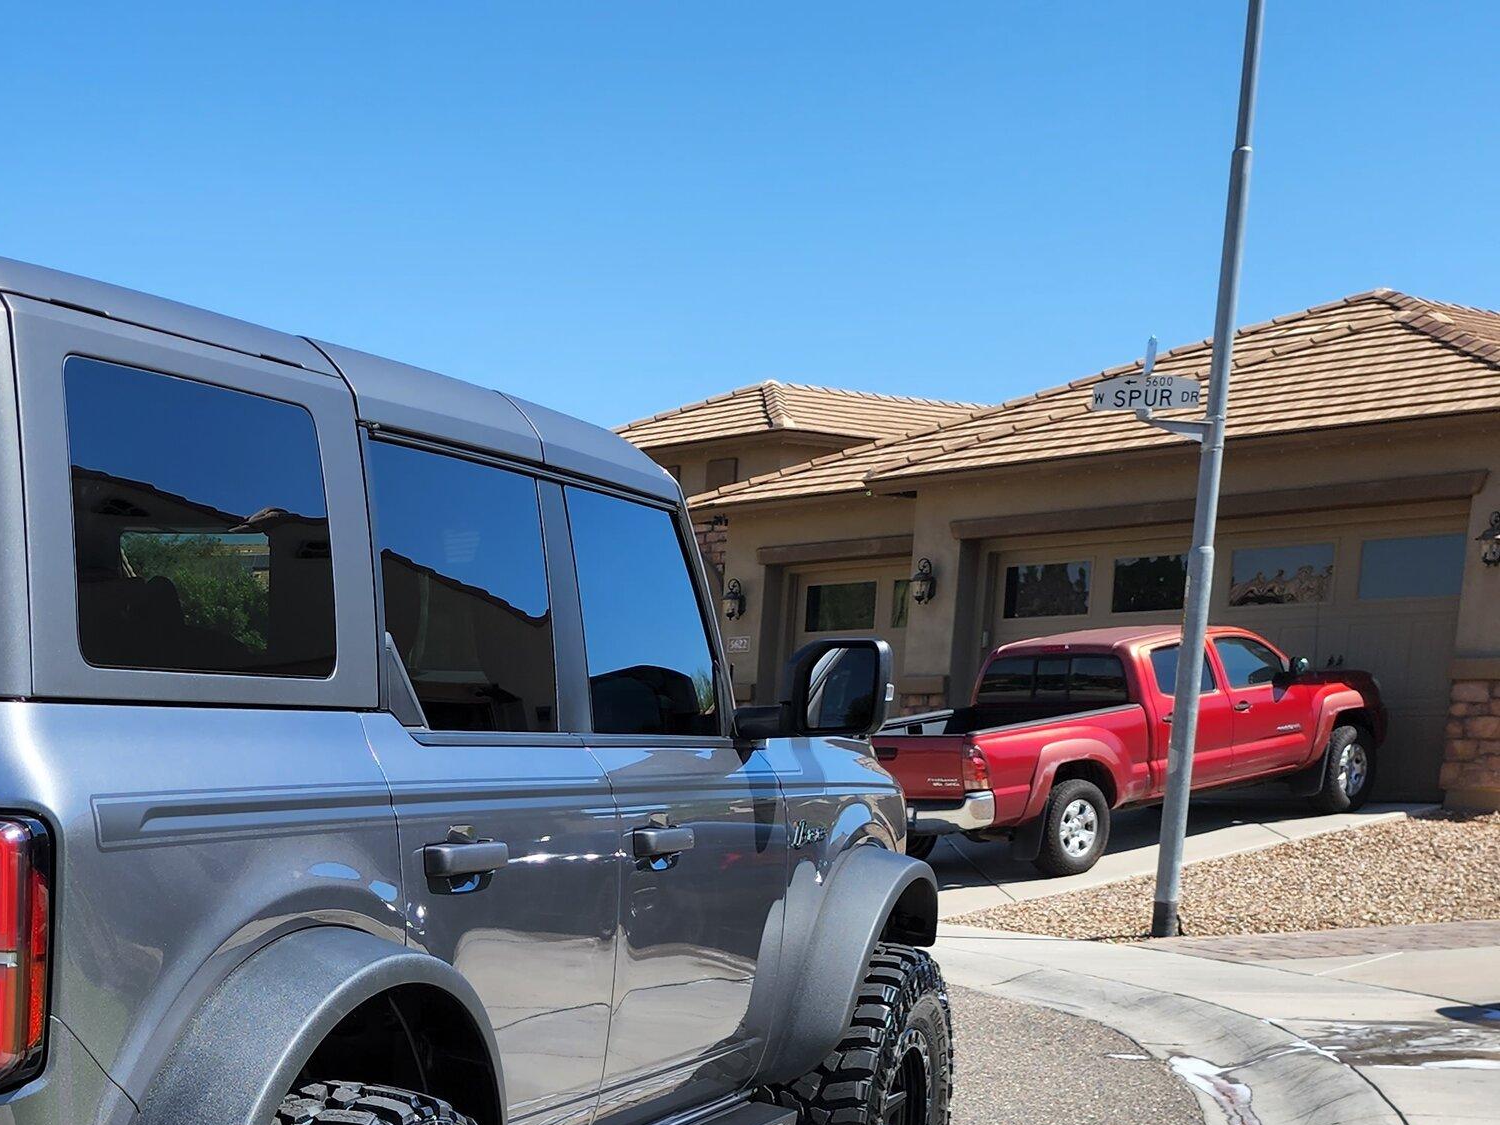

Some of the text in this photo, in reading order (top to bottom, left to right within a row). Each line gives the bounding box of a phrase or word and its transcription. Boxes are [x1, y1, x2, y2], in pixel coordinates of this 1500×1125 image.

[1146, 377, 1173, 386] 5600
[1094, 389, 1199, 408] W SPUR DR
